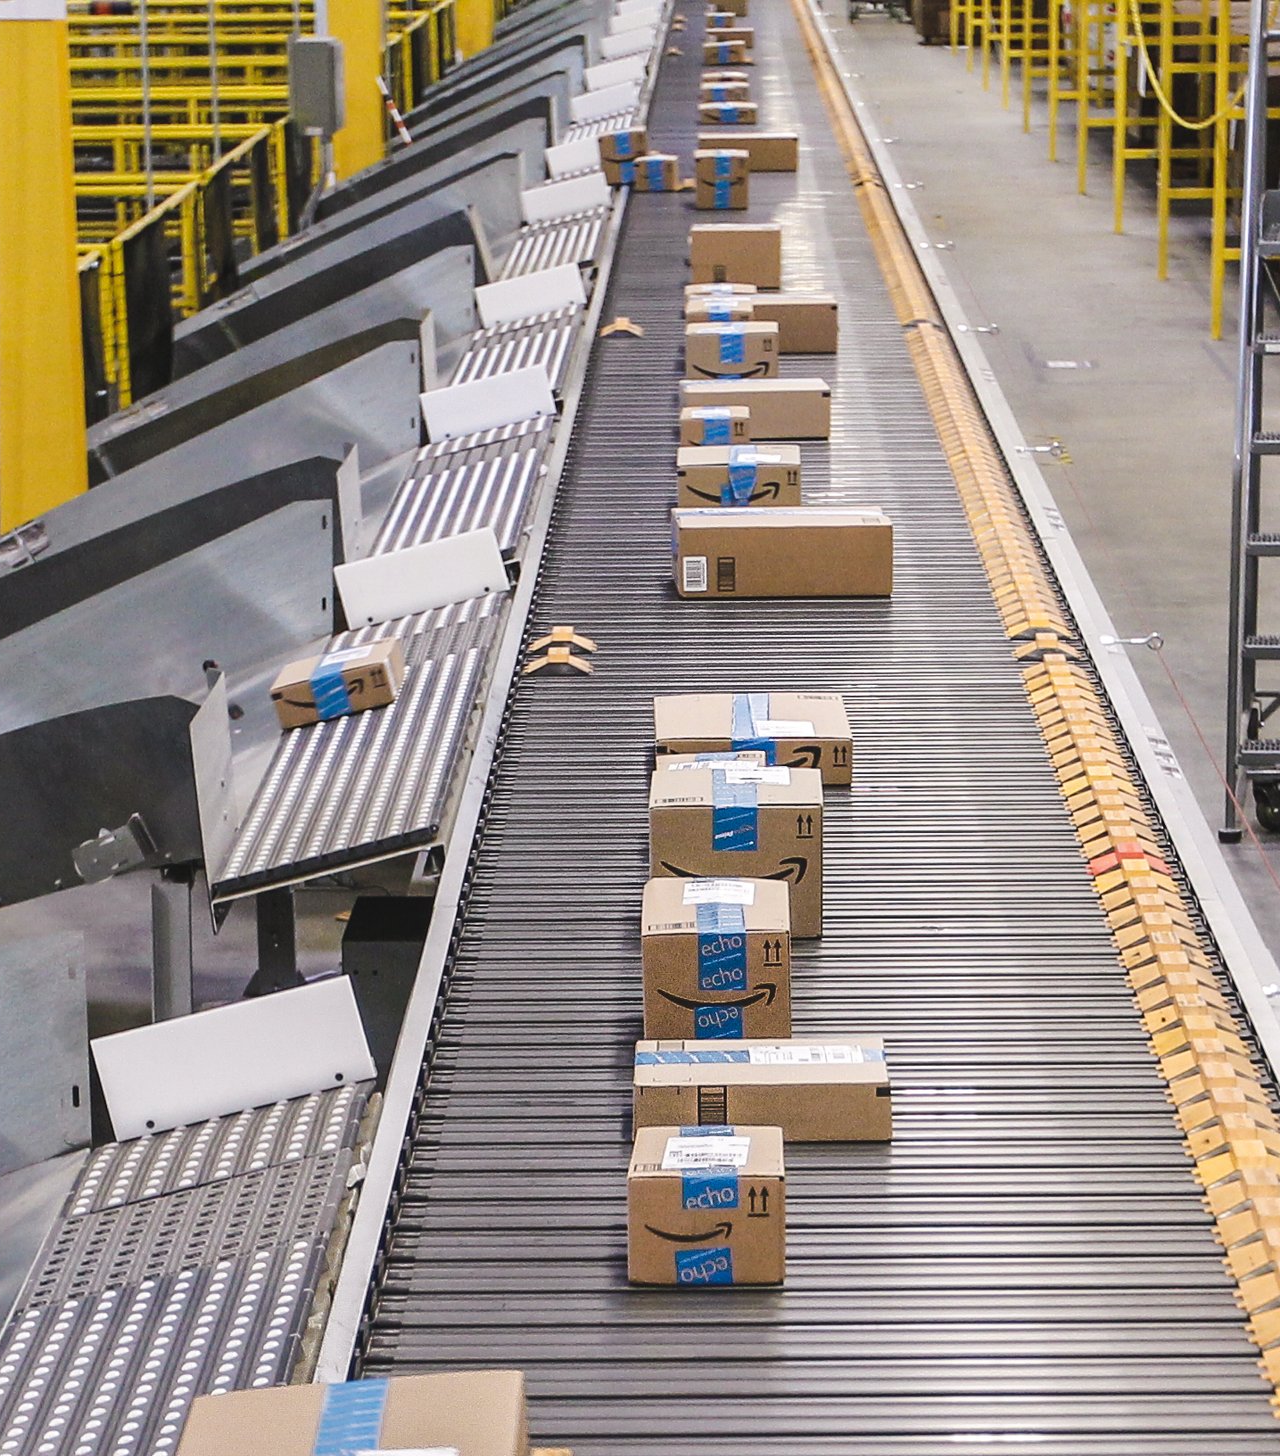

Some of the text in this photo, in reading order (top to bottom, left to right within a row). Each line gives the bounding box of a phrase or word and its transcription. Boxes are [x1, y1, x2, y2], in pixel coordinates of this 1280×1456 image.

[701, 935, 743, 957] echo
[702, 967, 744, 988] echo
[698, 1006, 740, 1029] echo
[686, 1186, 735, 1209] echo
[681, 1257, 729, 1282] echo
